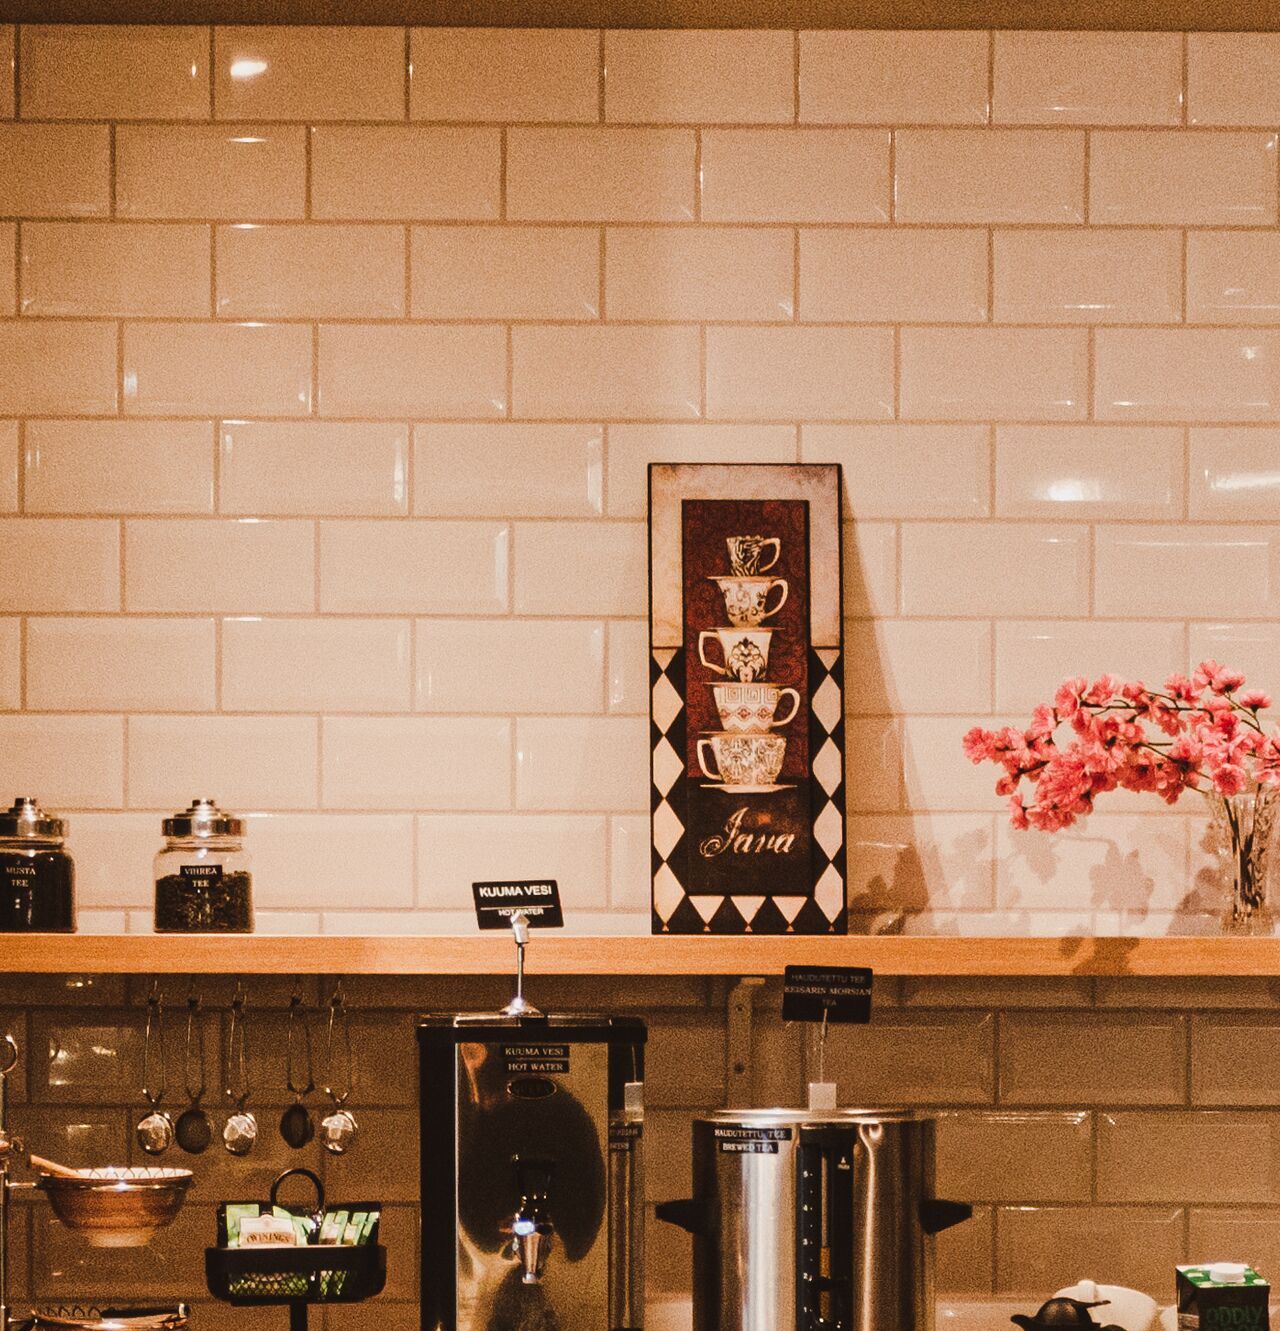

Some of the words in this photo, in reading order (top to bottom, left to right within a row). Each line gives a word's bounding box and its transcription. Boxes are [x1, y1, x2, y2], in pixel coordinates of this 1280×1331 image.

[699, 806, 795, 857] Java
[11, 879, 29, 887] TEE
[192, 879, 209, 888] TEE
[479, 886, 523, 897] KUUMA
[524, 885, 552, 896] VESI
[498, 908, 514, 916] HOT
[505, 1048, 539, 1056] KUUMA
[542, 1048, 564, 1056] VESI
[508, 1063, 527, 1071] HOT
[531, 1063, 563, 1071] WATER
[723, 1143, 755, 1151] BREWED
[756, 1144, 773, 1152] TEA
